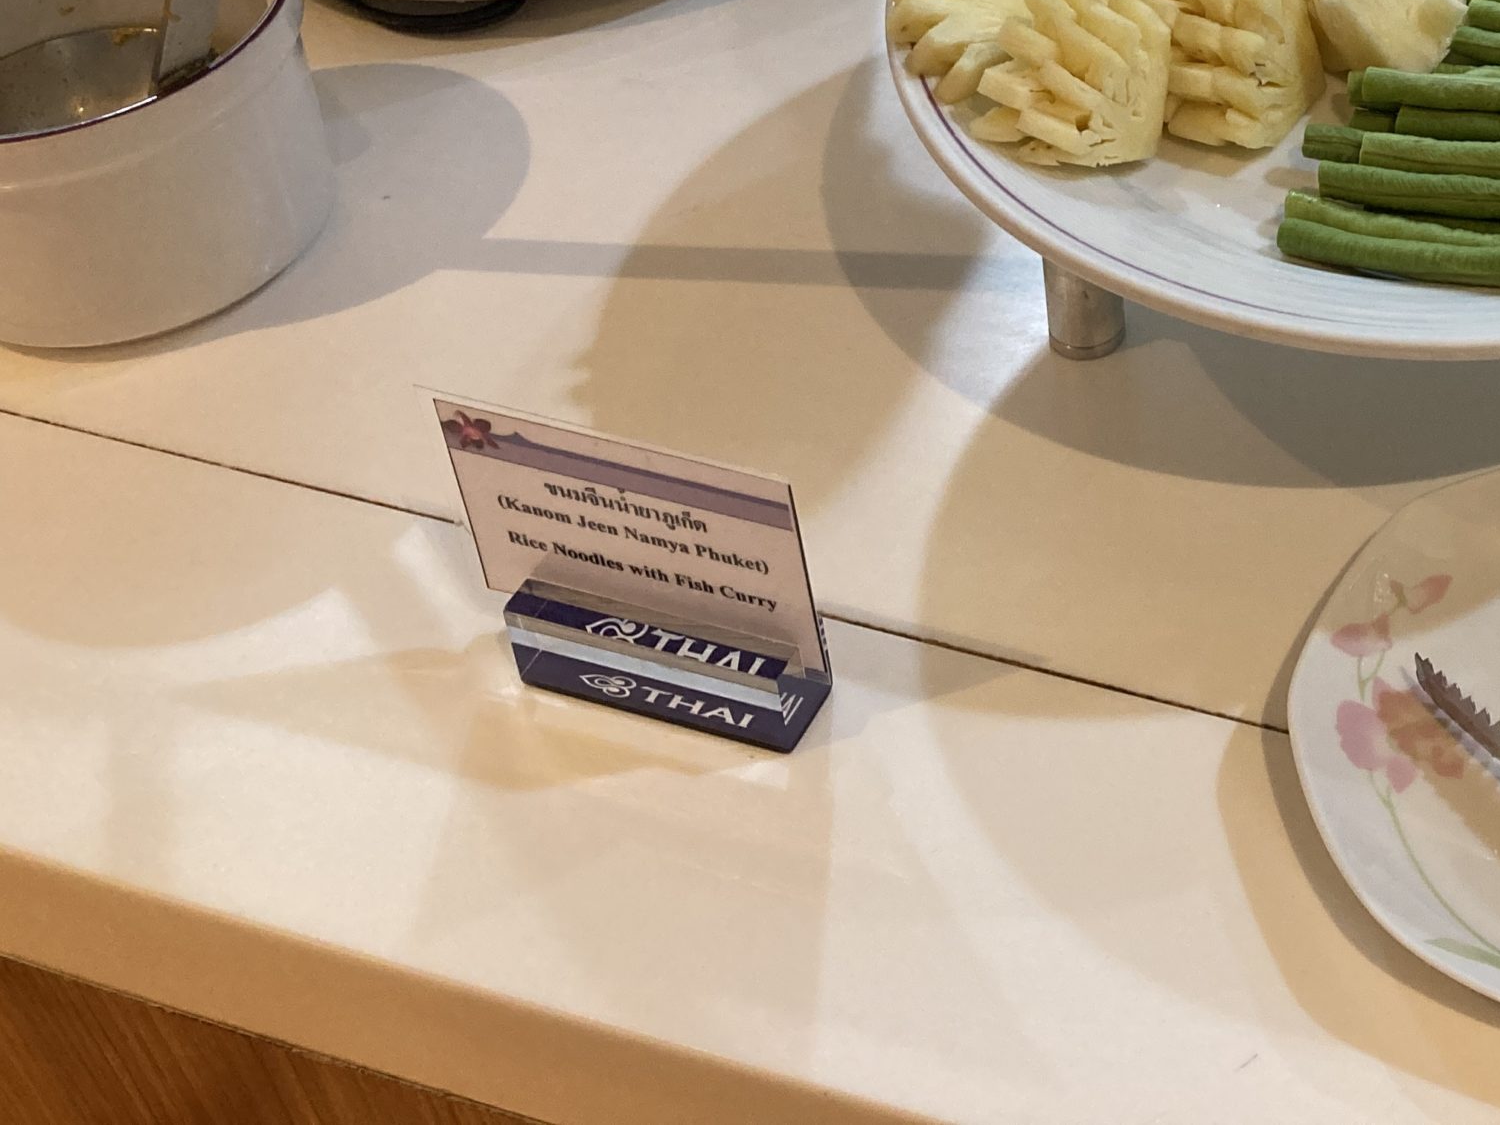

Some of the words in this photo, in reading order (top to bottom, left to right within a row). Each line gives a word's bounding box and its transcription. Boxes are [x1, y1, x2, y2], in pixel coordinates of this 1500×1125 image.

[497, 494, 572, 525] (Kanom
[577, 515, 618, 536] Jeen
[624, 526, 690, 555] Namya
[696, 543, 769, 575] Phuket)
[543, 482, 708, 534] ขนมจีนน้ำยาภูเก็ต
[508, 530, 548, 552] Rice
[552, 542, 624, 572] Noodles
[628, 561, 669, 583] with
[674, 572, 715, 594] Fish
[719, 585, 778, 613] Curry
[640, 685, 756, 729] THAI
